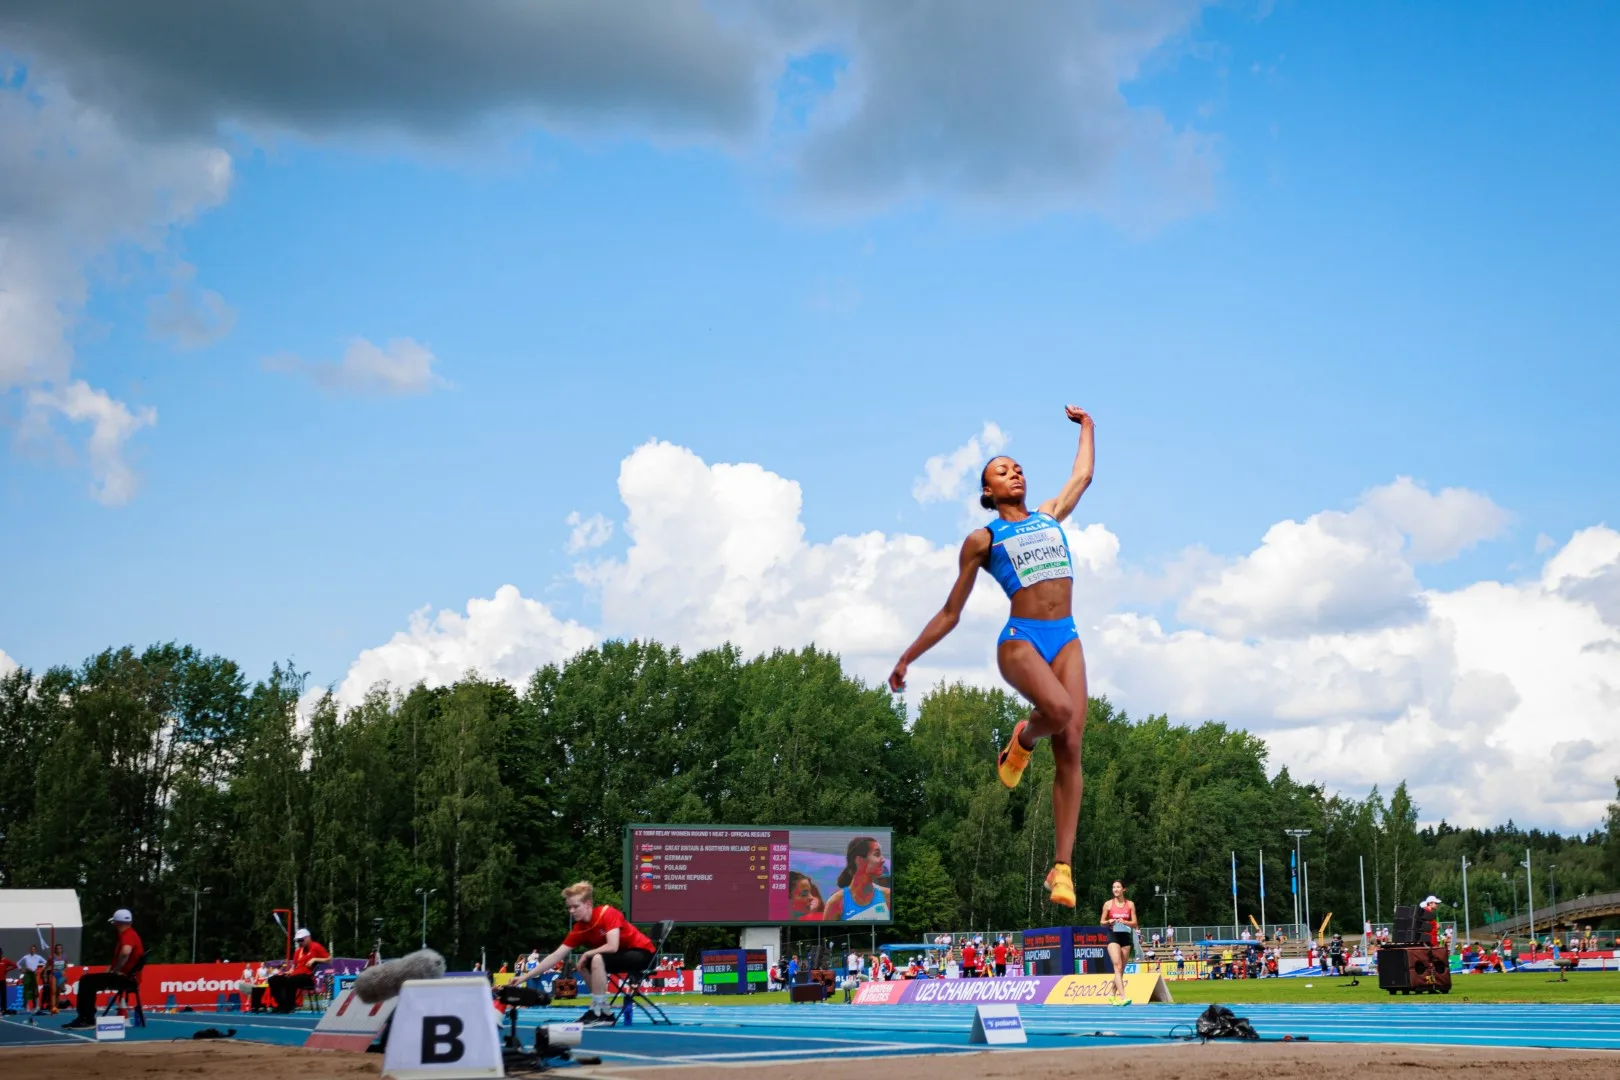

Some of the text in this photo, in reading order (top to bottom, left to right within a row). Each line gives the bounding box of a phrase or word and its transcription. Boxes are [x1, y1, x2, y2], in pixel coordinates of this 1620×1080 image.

[1015, 522, 1050, 533] ITALIA
[1012, 545, 1067, 570] IAPICHINO
[1028, 571, 1053, 582] ESPOO
[1025, 950, 1050, 960] IAPICHINO
[1074, 948, 1104, 958] IAPICHINO
[916, 980, 1040, 1001] U23 CHAMPIONSHIPS
[1064, 981, 1097, 1002] Espoo
[421, 1015, 465, 1064] B
